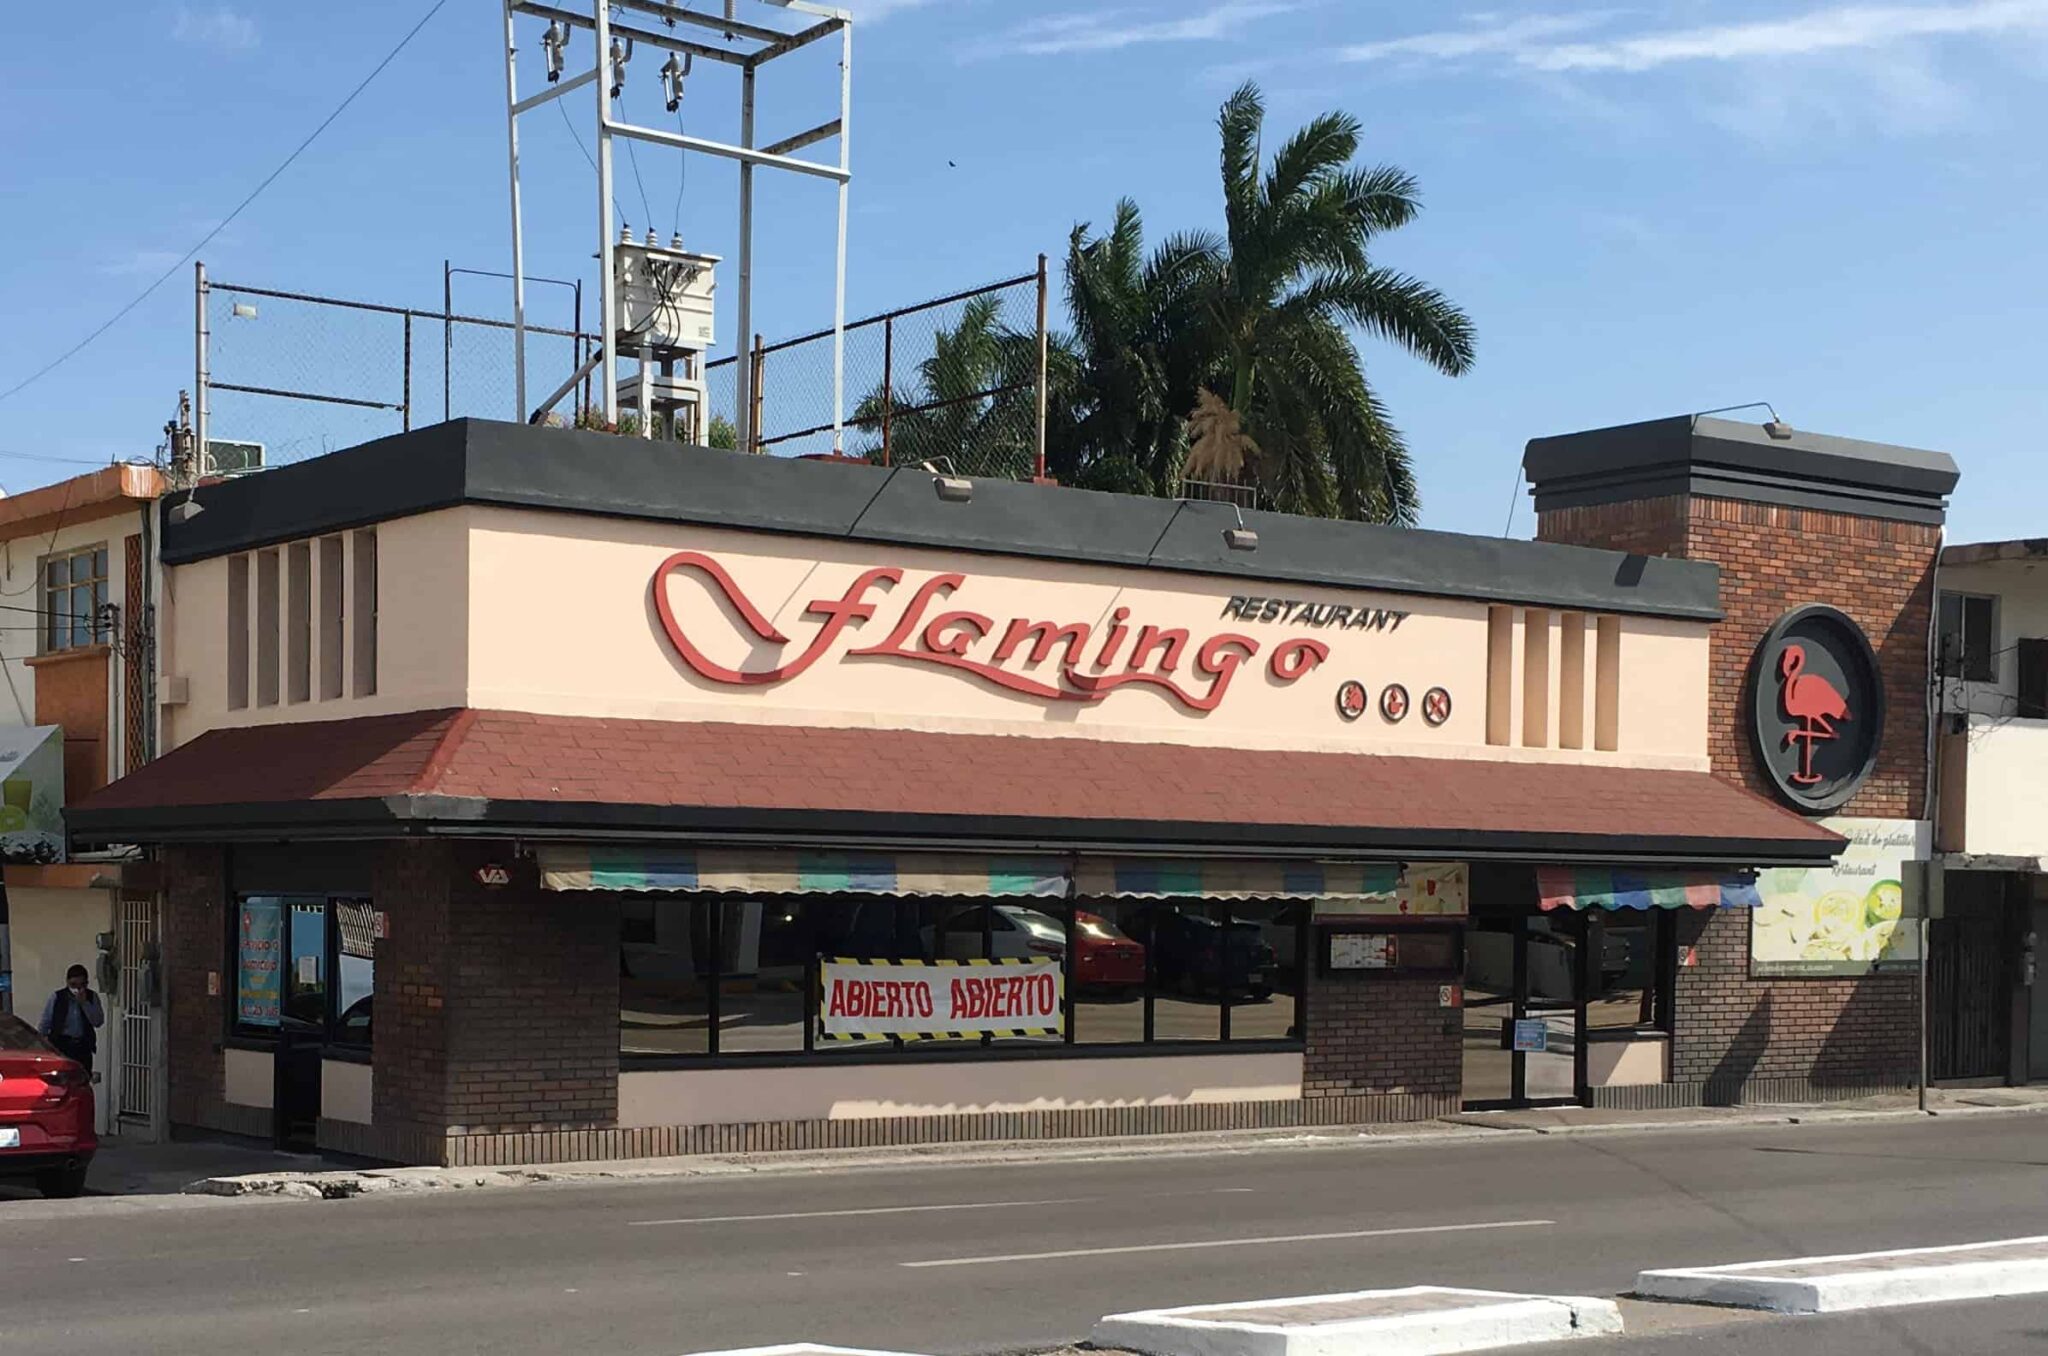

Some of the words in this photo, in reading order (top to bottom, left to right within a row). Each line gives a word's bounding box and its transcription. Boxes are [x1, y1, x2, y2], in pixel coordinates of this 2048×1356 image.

[1220, 596, 1410, 632] RESTAURANT
[829, 979, 933, 1018] ABIERTO
[950, 973, 1055, 1019] ABIERTO
